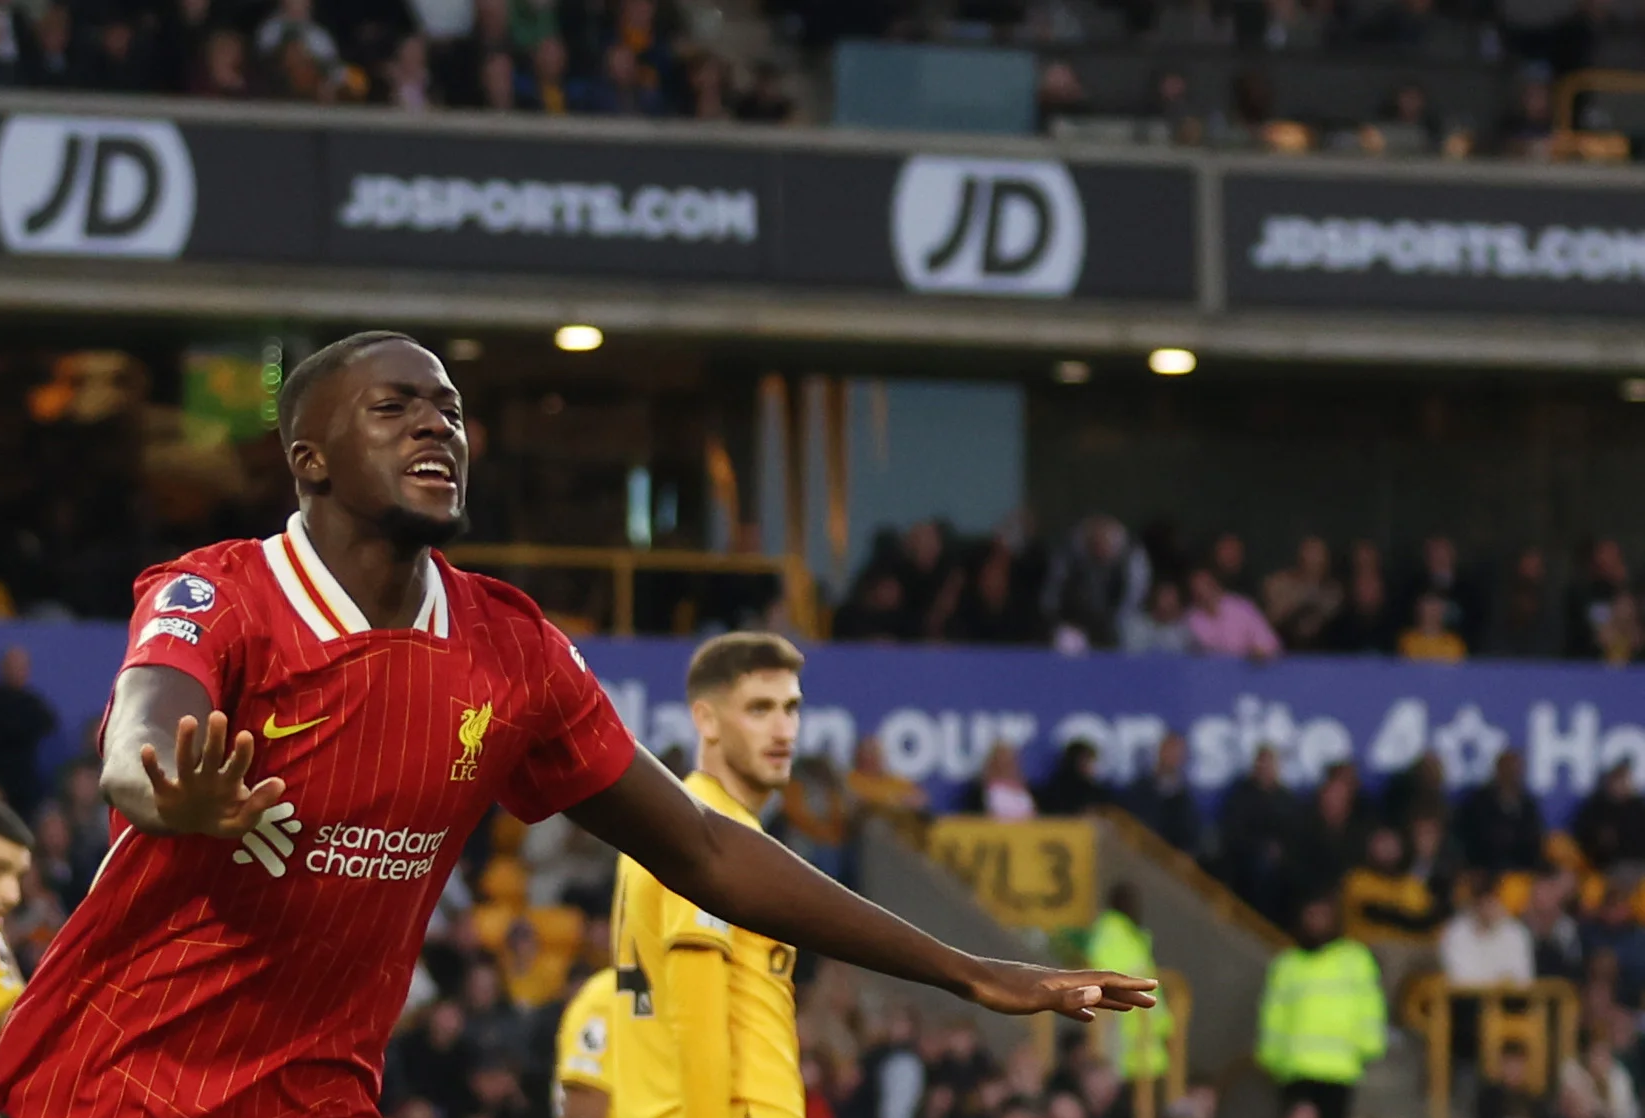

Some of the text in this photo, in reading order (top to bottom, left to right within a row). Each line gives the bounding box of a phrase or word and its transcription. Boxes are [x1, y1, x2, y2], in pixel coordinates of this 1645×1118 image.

[24, 131, 159, 239] JD
[339, 173, 759, 243] JDSPORTS.COM
[926, 176, 1058, 275] JD
[878, 707, 1036, 781] our
[305, 845, 439, 881] chartered
[314, 821, 451, 854] standard
